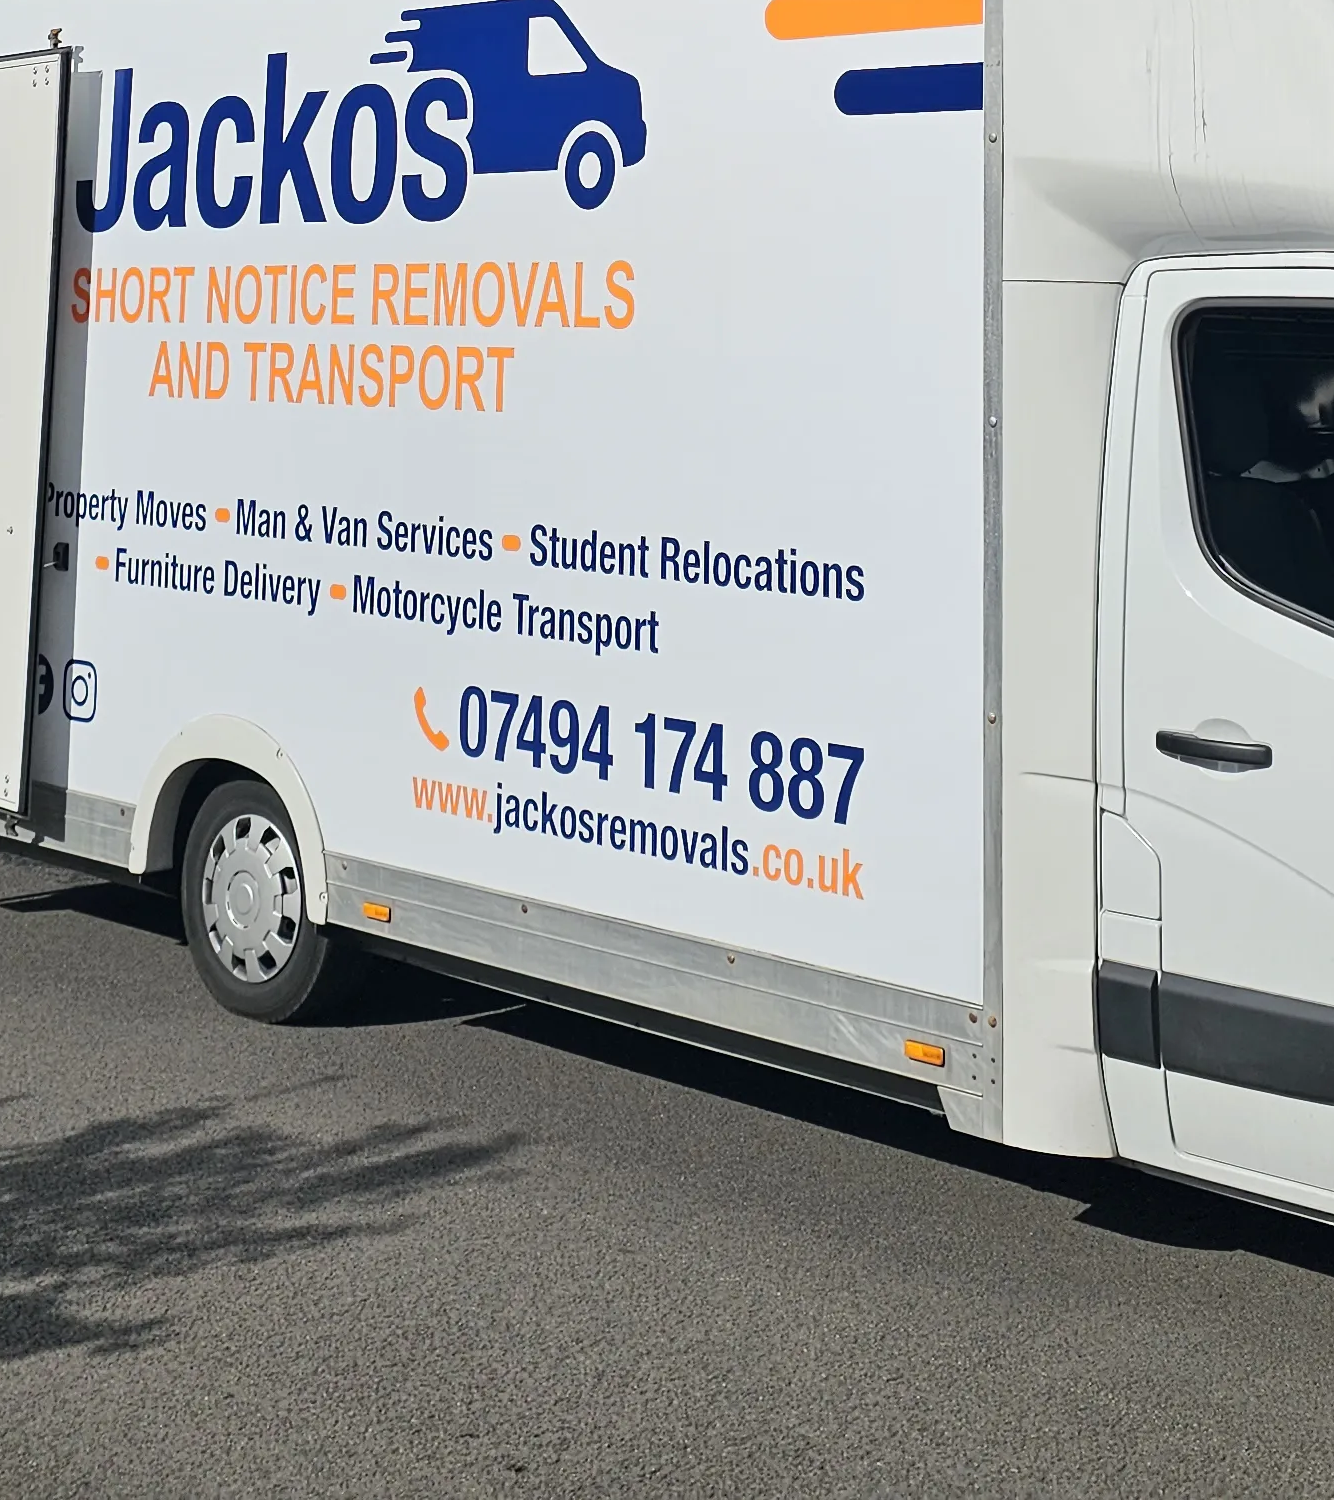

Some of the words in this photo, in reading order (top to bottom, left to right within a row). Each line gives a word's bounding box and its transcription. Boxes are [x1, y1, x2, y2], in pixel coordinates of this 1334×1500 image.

[75, 52, 468, 233] Jackos
[71, 266, 195, 325] SHORT
[206, 263, 355, 326] NOTICE
[371, 260, 635, 329] REMOVALS
[149, 340, 229, 400] AND
[244, 342, 515, 412] TRANSPORT
[135, 490, 207, 531] Moves
[236, 499, 287, 540] Man
[295, 503, 313, 542] &
[321, 506, 367, 548] Van
[377, 511, 493, 561] Services
[529, 524, 650, 578] Student
[660, 536, 865, 601] Relocations
[114, 548, 215, 594] Furniture
[224, 560, 321, 616] Delivery
[353, 575, 502, 634] Motorcycle
[513, 593, 660, 656] Transport
[459, 686, 613, 781] 07494
[634, 713, 727, 802] 174
[748, 731, 865, 825] 887
[412, 776, 865, 900] www.jackosremovals.co.uk
